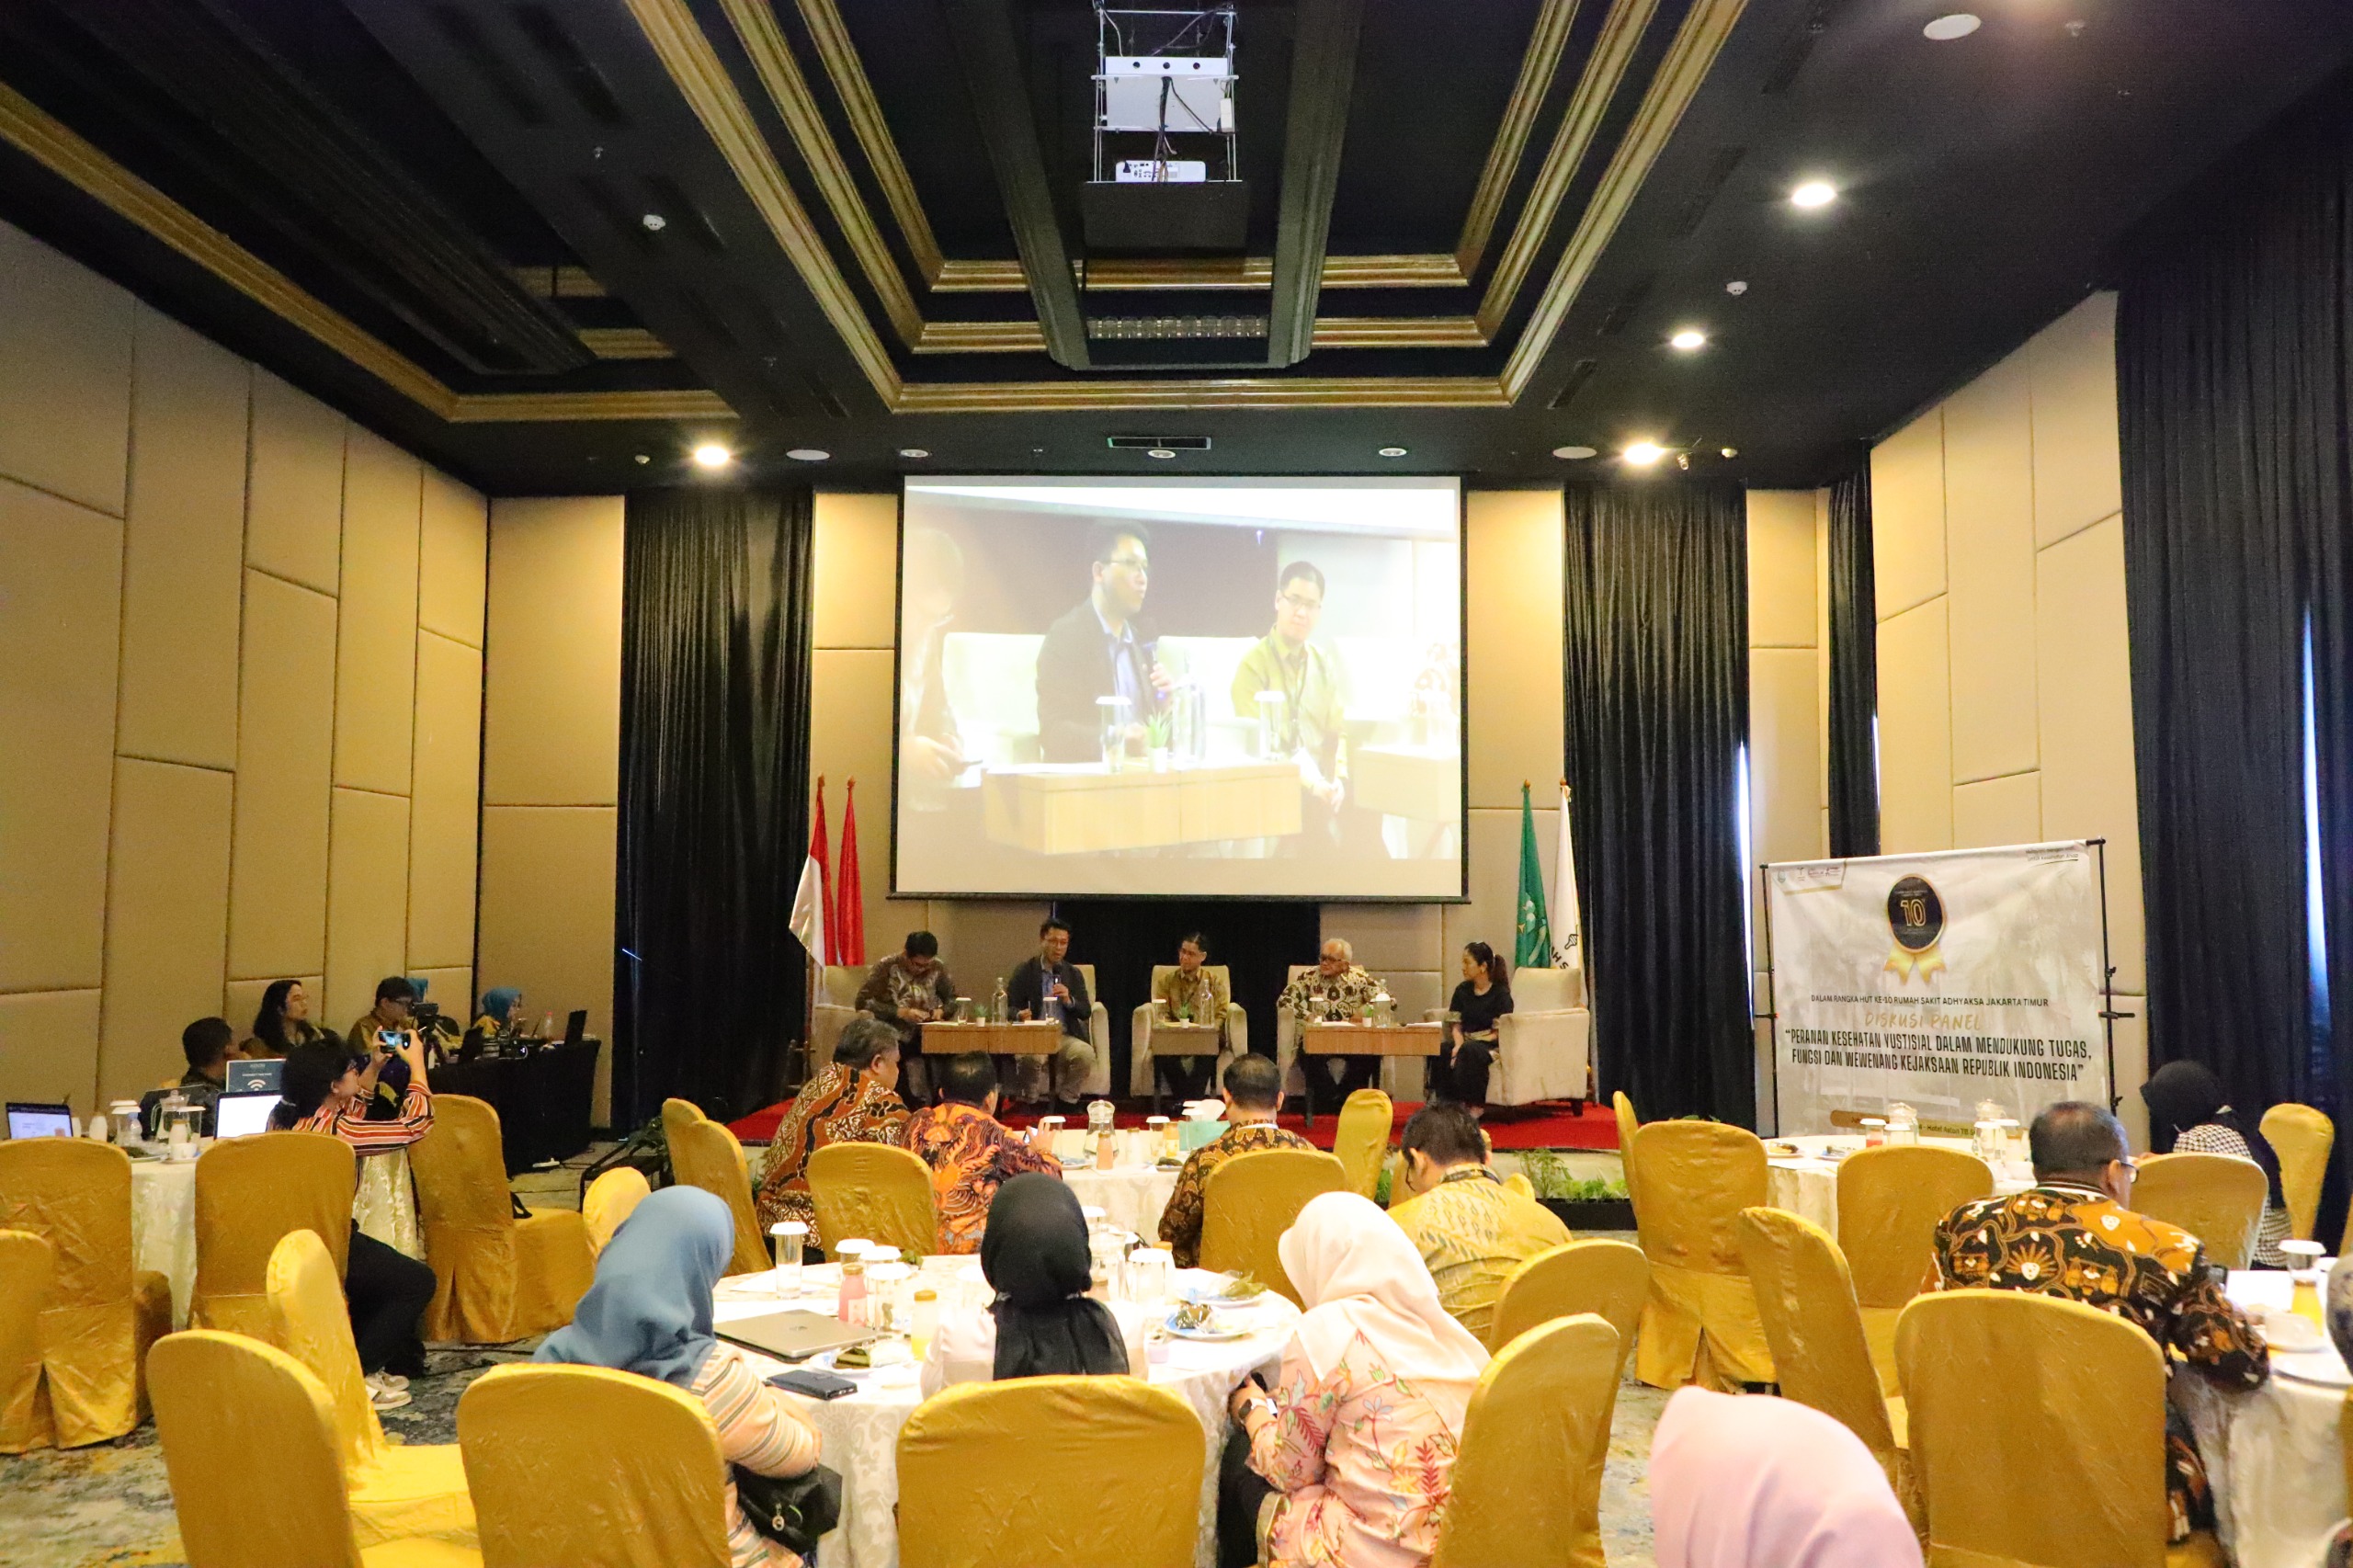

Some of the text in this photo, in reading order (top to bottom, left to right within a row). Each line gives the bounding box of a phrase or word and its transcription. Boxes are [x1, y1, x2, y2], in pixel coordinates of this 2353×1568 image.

[1900, 898, 1927, 926] 10
[1811, 994, 2049, 1007] DALAM RANGKA HUT KE-10 RUMAH SAKIT ADHYAKSA JAKARTA TIMUR
[1865, 1010, 1982, 1030] DISKUSI PANEL
[1832, 1030, 1881, 1049] KESEHATAN
[1884, 1032, 1932, 1051] YUSTISIAL
[1936, 1035, 1972, 1053] DALAM
[1976, 1037, 2044, 1057] MENDUKUNG
[2048, 1040, 2092, 1061] TUGAS,
[1792, 1048, 1822, 1064] FUNGSI
[1824, 1050, 1843, 1066] DAN
[1845, 1051, 1898, 1071] WEWENANG
[1900, 1054, 1959, 1074] KEJAKSAAN
[1962, 1058, 2010, 1078] REPUBLIK
